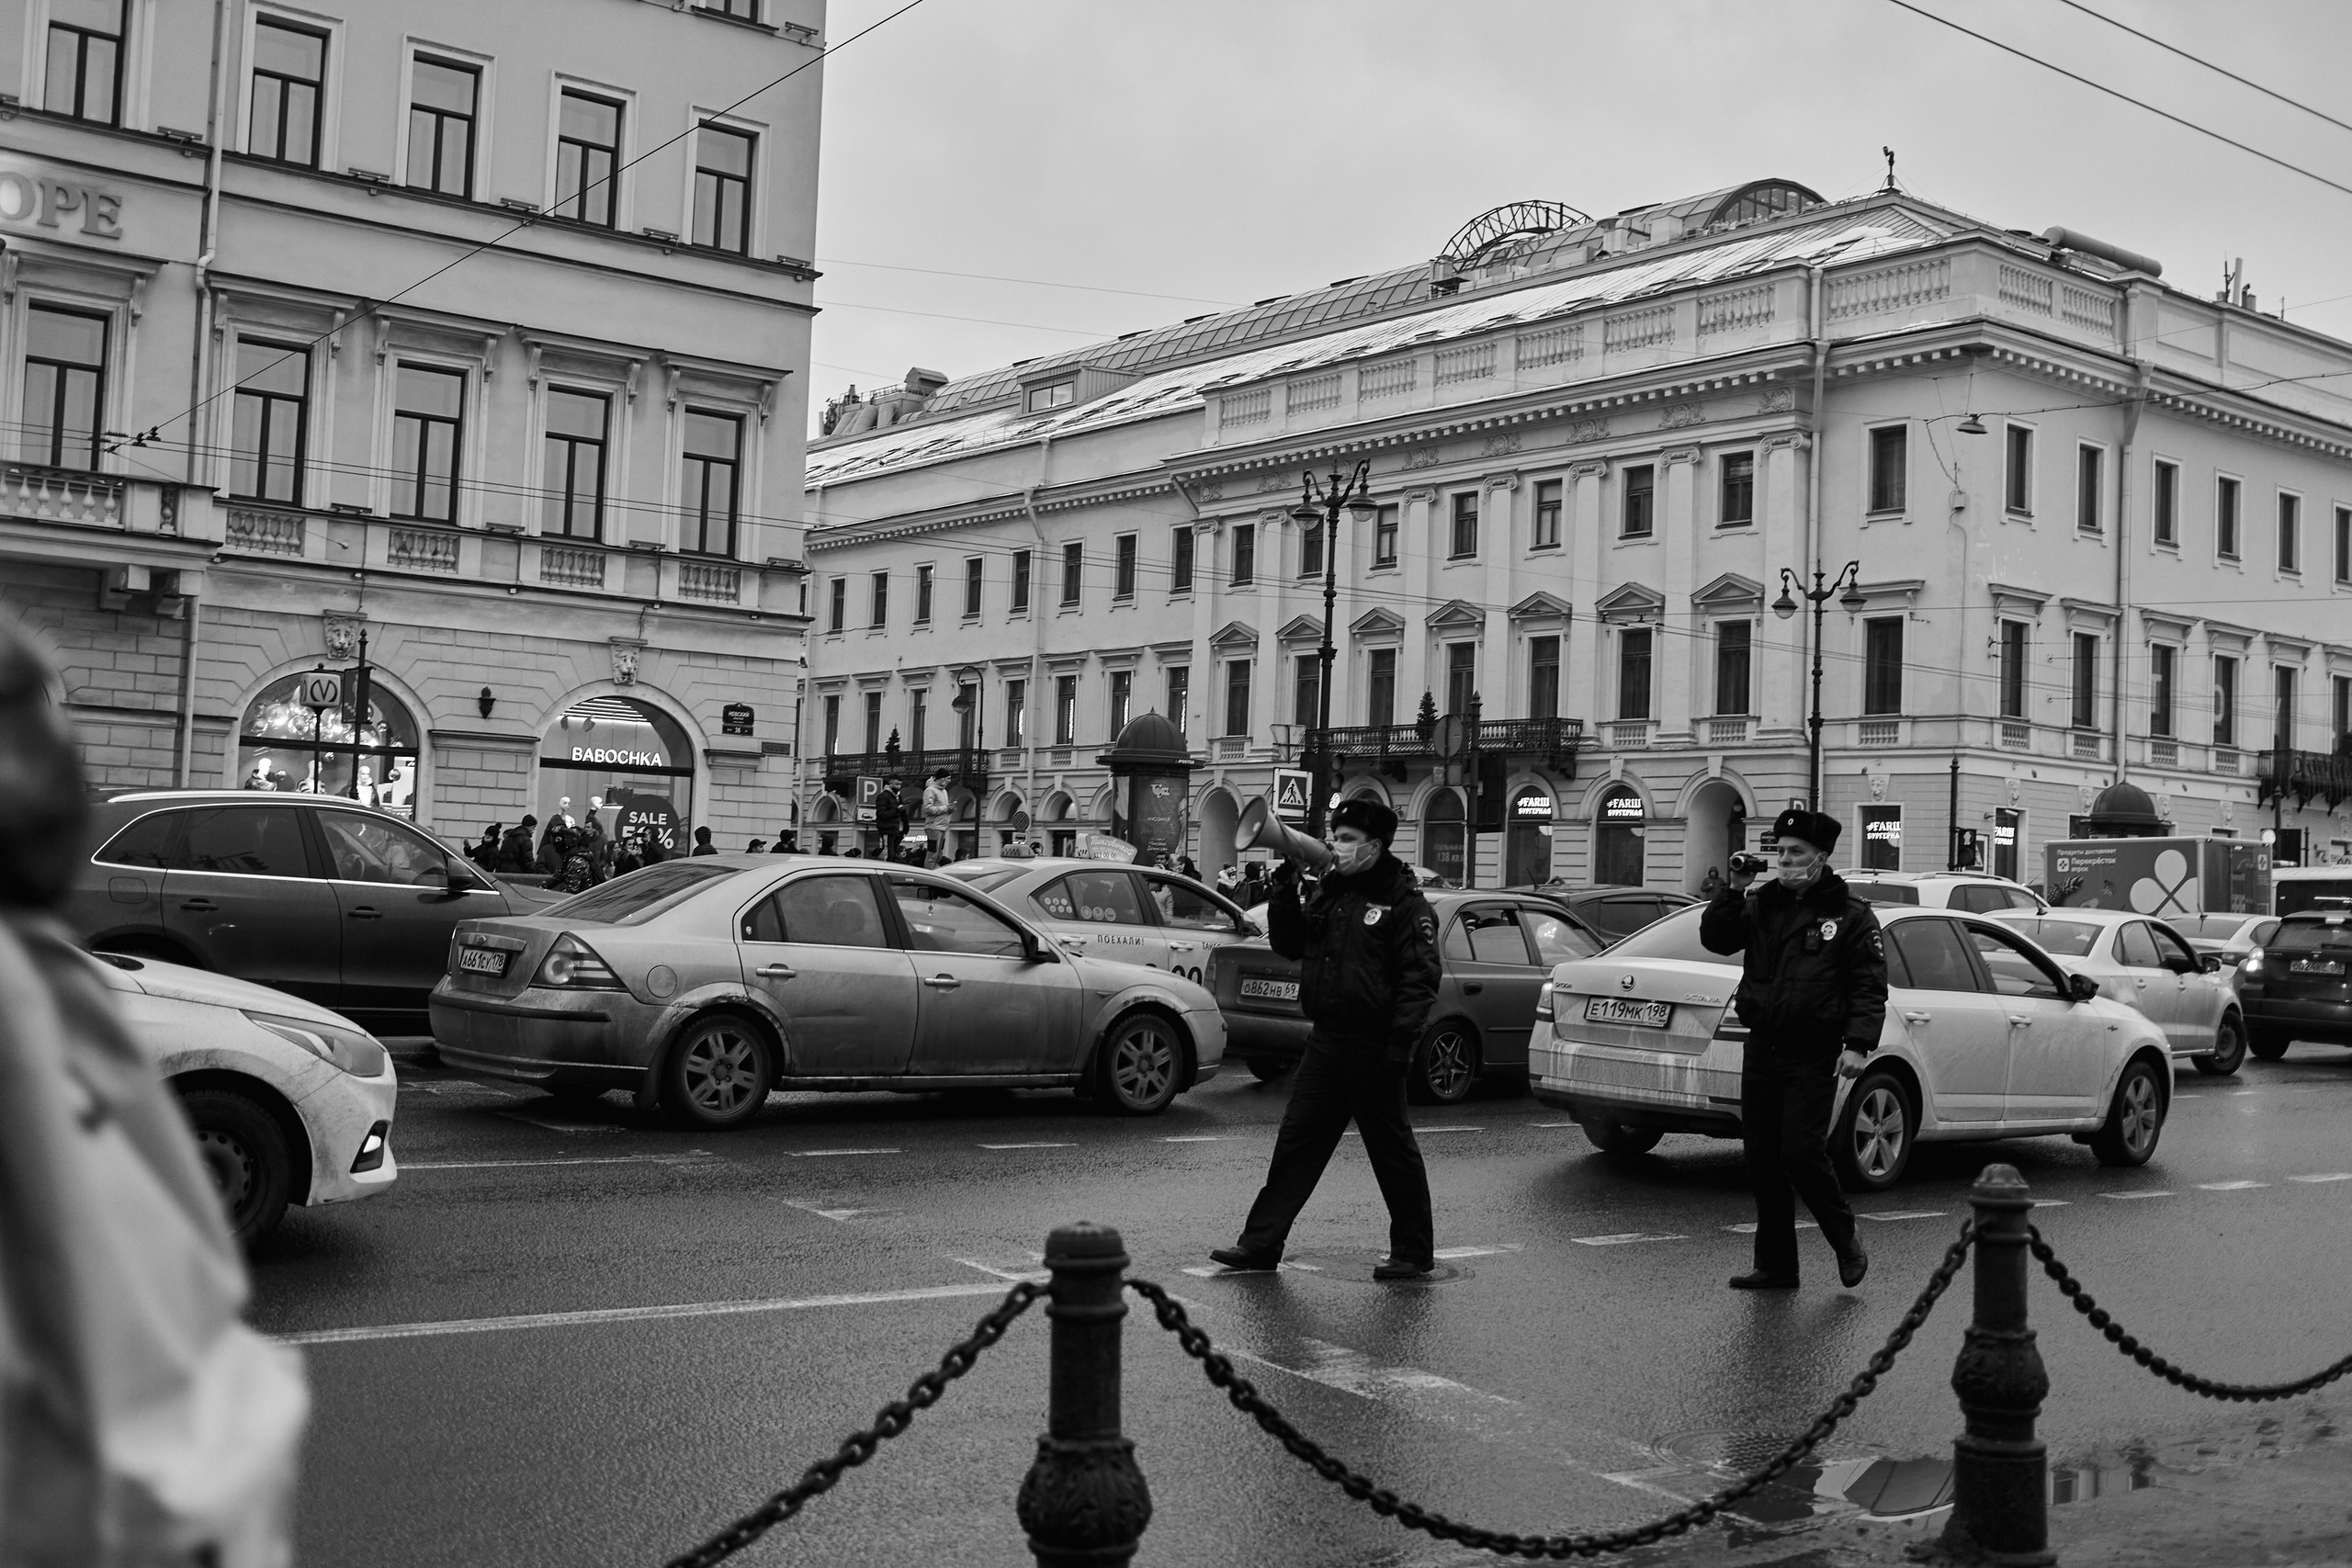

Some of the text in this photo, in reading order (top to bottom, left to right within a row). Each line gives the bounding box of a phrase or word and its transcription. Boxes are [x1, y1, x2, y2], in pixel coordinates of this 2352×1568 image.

[0, 171, 122, 239] OPE
[571, 746, 662, 767] BABOCHKA
[864, 780, 877, 803] P
[628, 811, 668, 825] SALE
[2071, 857, 2117, 865] Перекрёсток
[1097, 934, 1145, 946] ПОЕХАЛИ!
[1285, 983, 1296, 994] 69
[1683, 993, 1722, 1004] OCTAVIA
[1645, 1004, 1667, 1018] 198
